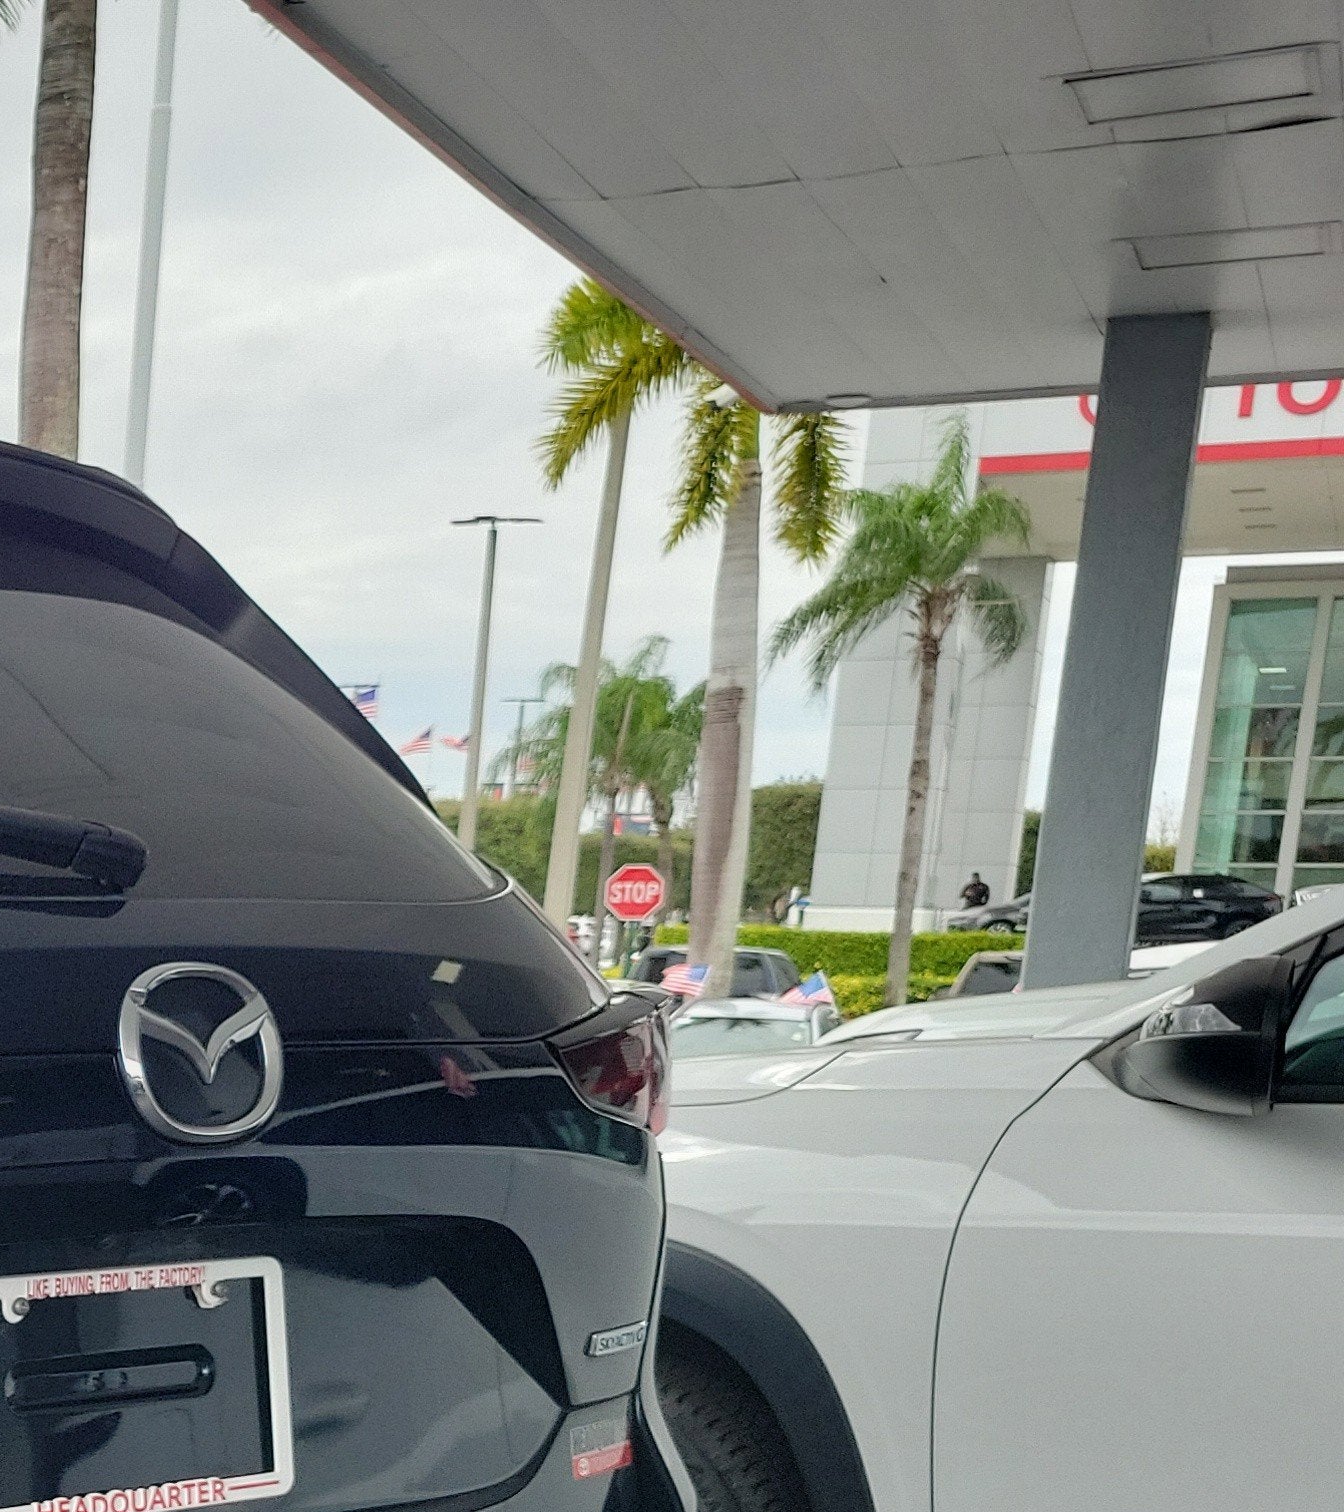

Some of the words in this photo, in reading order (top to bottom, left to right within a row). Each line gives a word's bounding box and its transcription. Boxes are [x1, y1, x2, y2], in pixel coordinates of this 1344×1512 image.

[609, 880, 660, 904] STOP
[26, 1278, 49, 1299] LIKE
[55, 1275, 93, 1296] BUYING
[99, 1272, 130, 1291] FROM
[135, 1269, 154, 1289] THE
